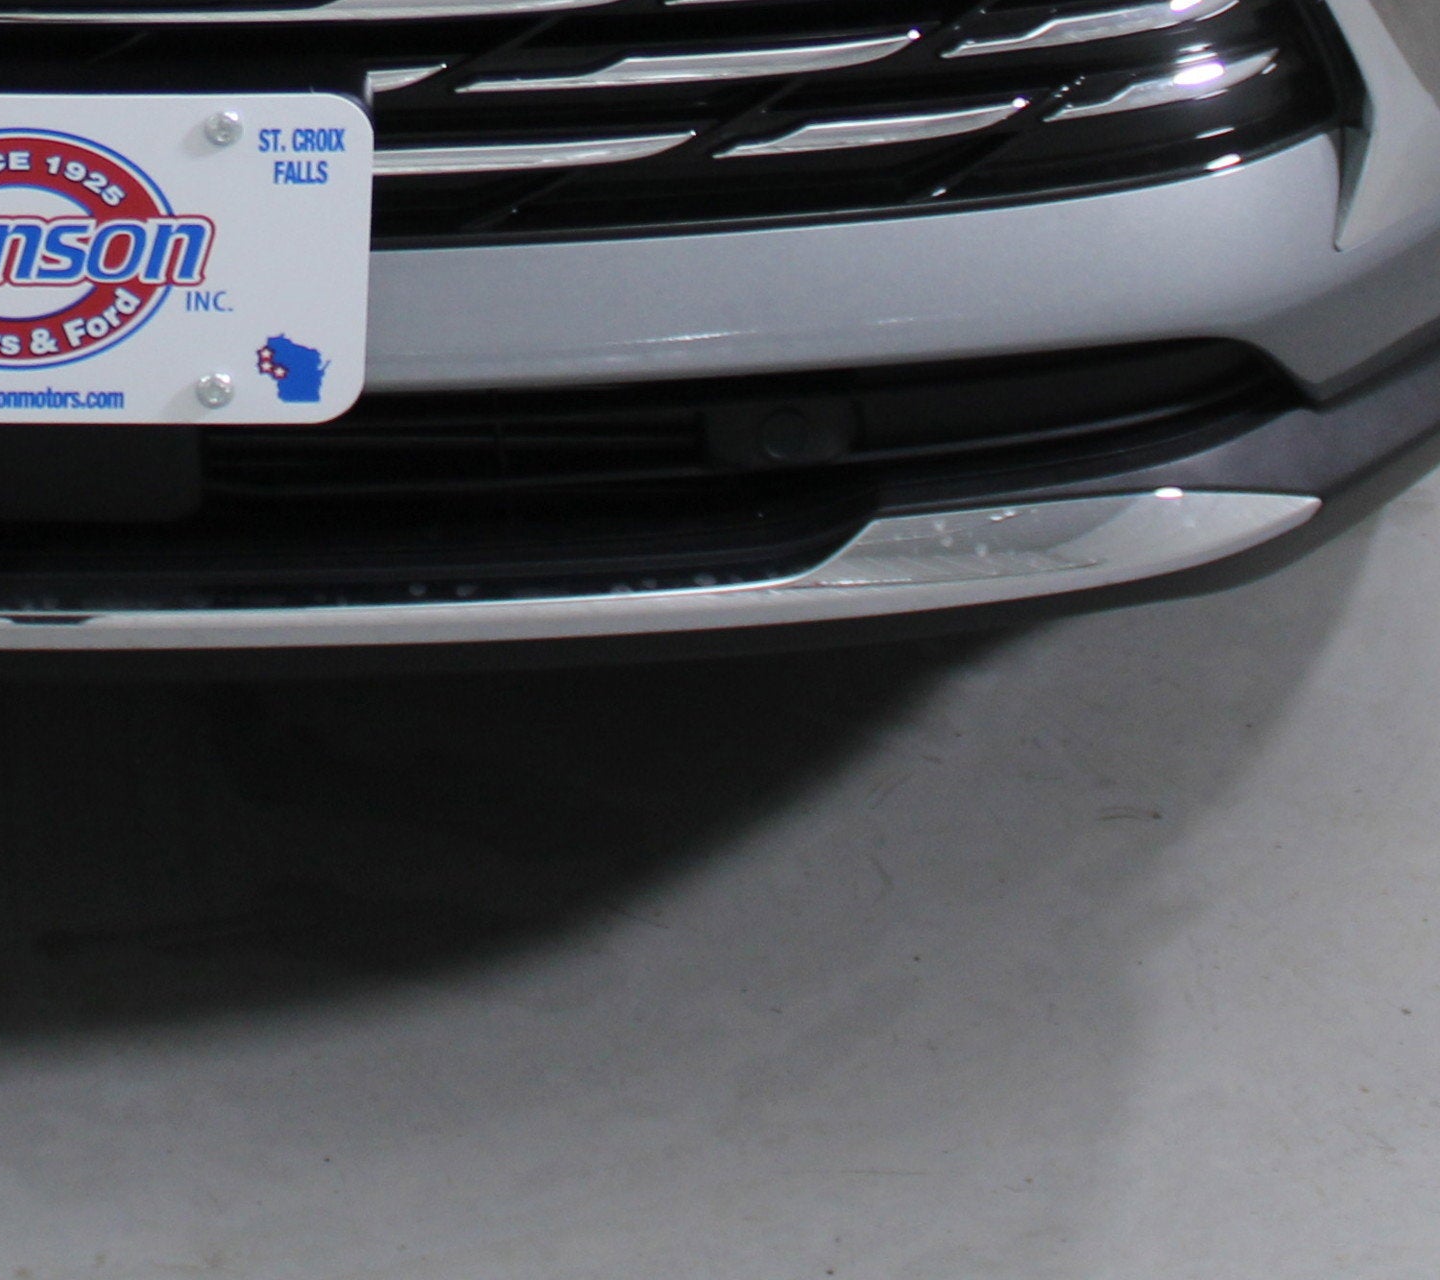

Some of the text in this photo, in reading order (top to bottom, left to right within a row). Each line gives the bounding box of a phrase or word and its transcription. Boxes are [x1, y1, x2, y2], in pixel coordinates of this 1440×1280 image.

[258, 128, 346, 153] ST. CROIX
[45, 154, 126, 207] 1925
[274, 160, 328, 185] FALLS
[185, 290, 234, 312] INC.
[29, 327, 59, 356] &
[63, 287, 142, 348] Ford
